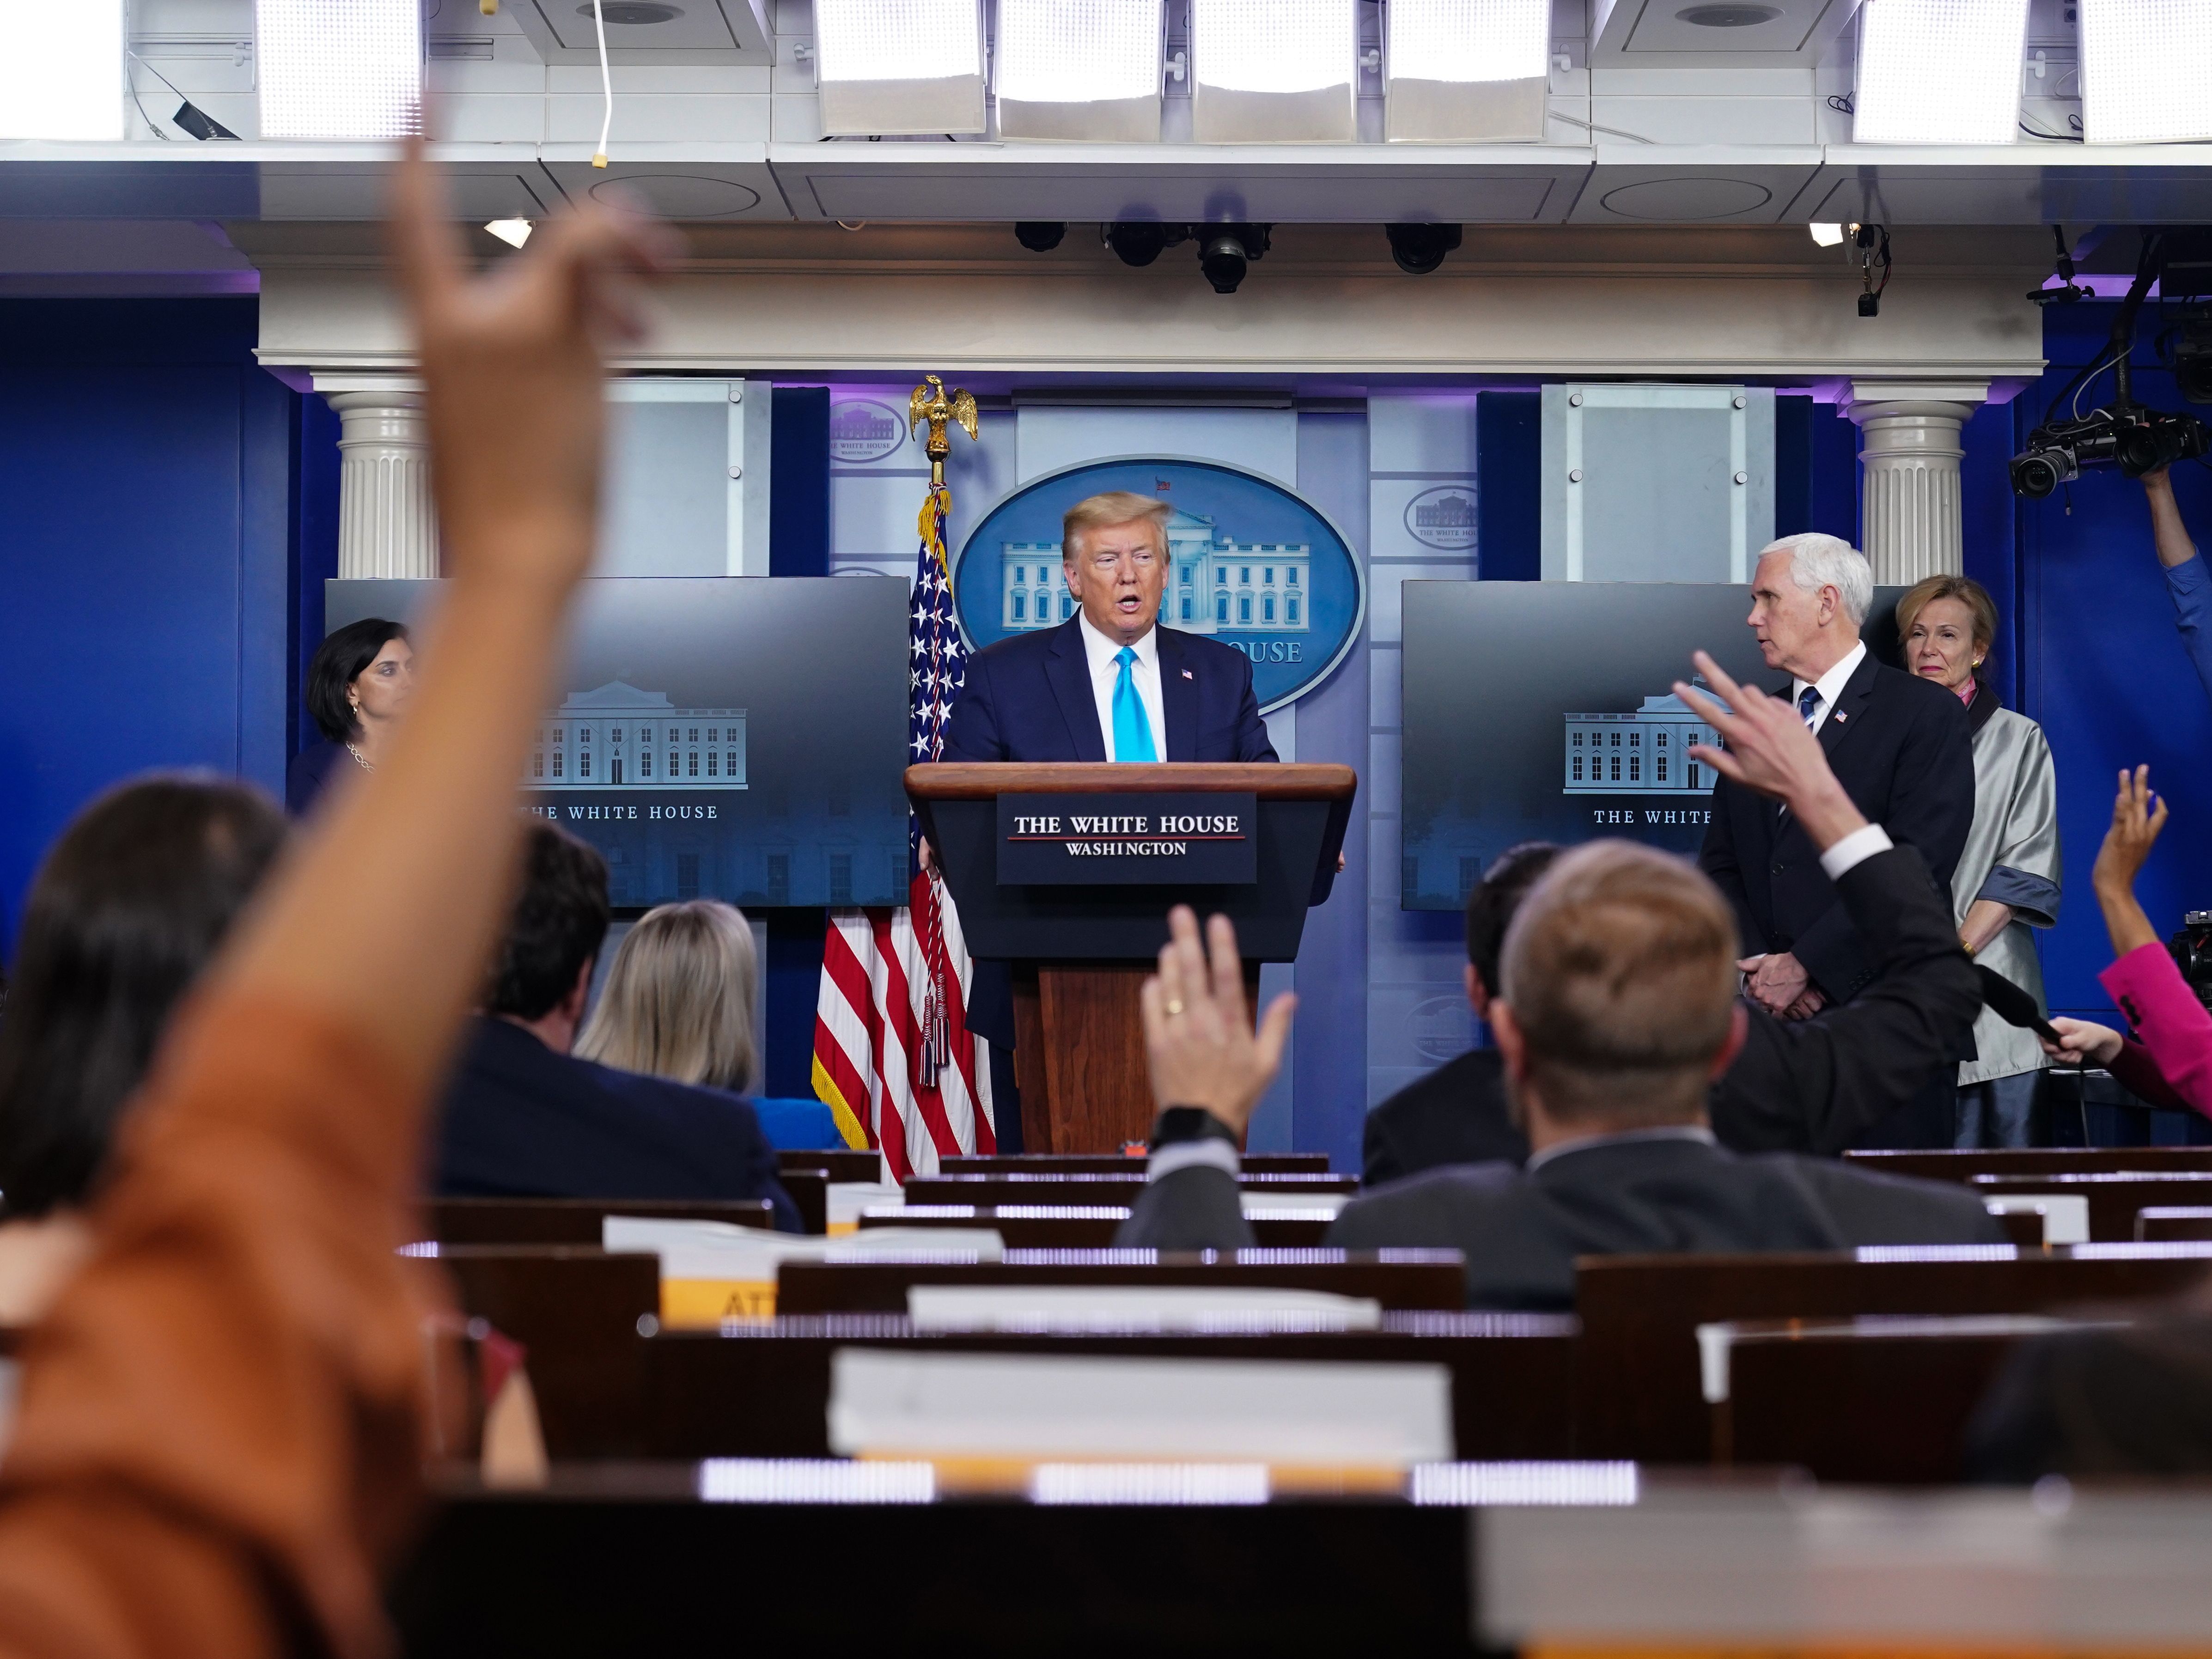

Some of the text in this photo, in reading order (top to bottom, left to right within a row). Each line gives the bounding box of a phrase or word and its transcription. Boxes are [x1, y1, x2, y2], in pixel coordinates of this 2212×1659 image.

[1228, 641, 1303, 663] USE
[568, 806, 638, 819] WHITE
[649, 806, 717, 819] HOUSE
[1594, 811, 1634, 823] THE
[1014, 816, 1240, 834] THE WHITE HOUSE
[1066, 842, 1187, 856] WASHINGTON
